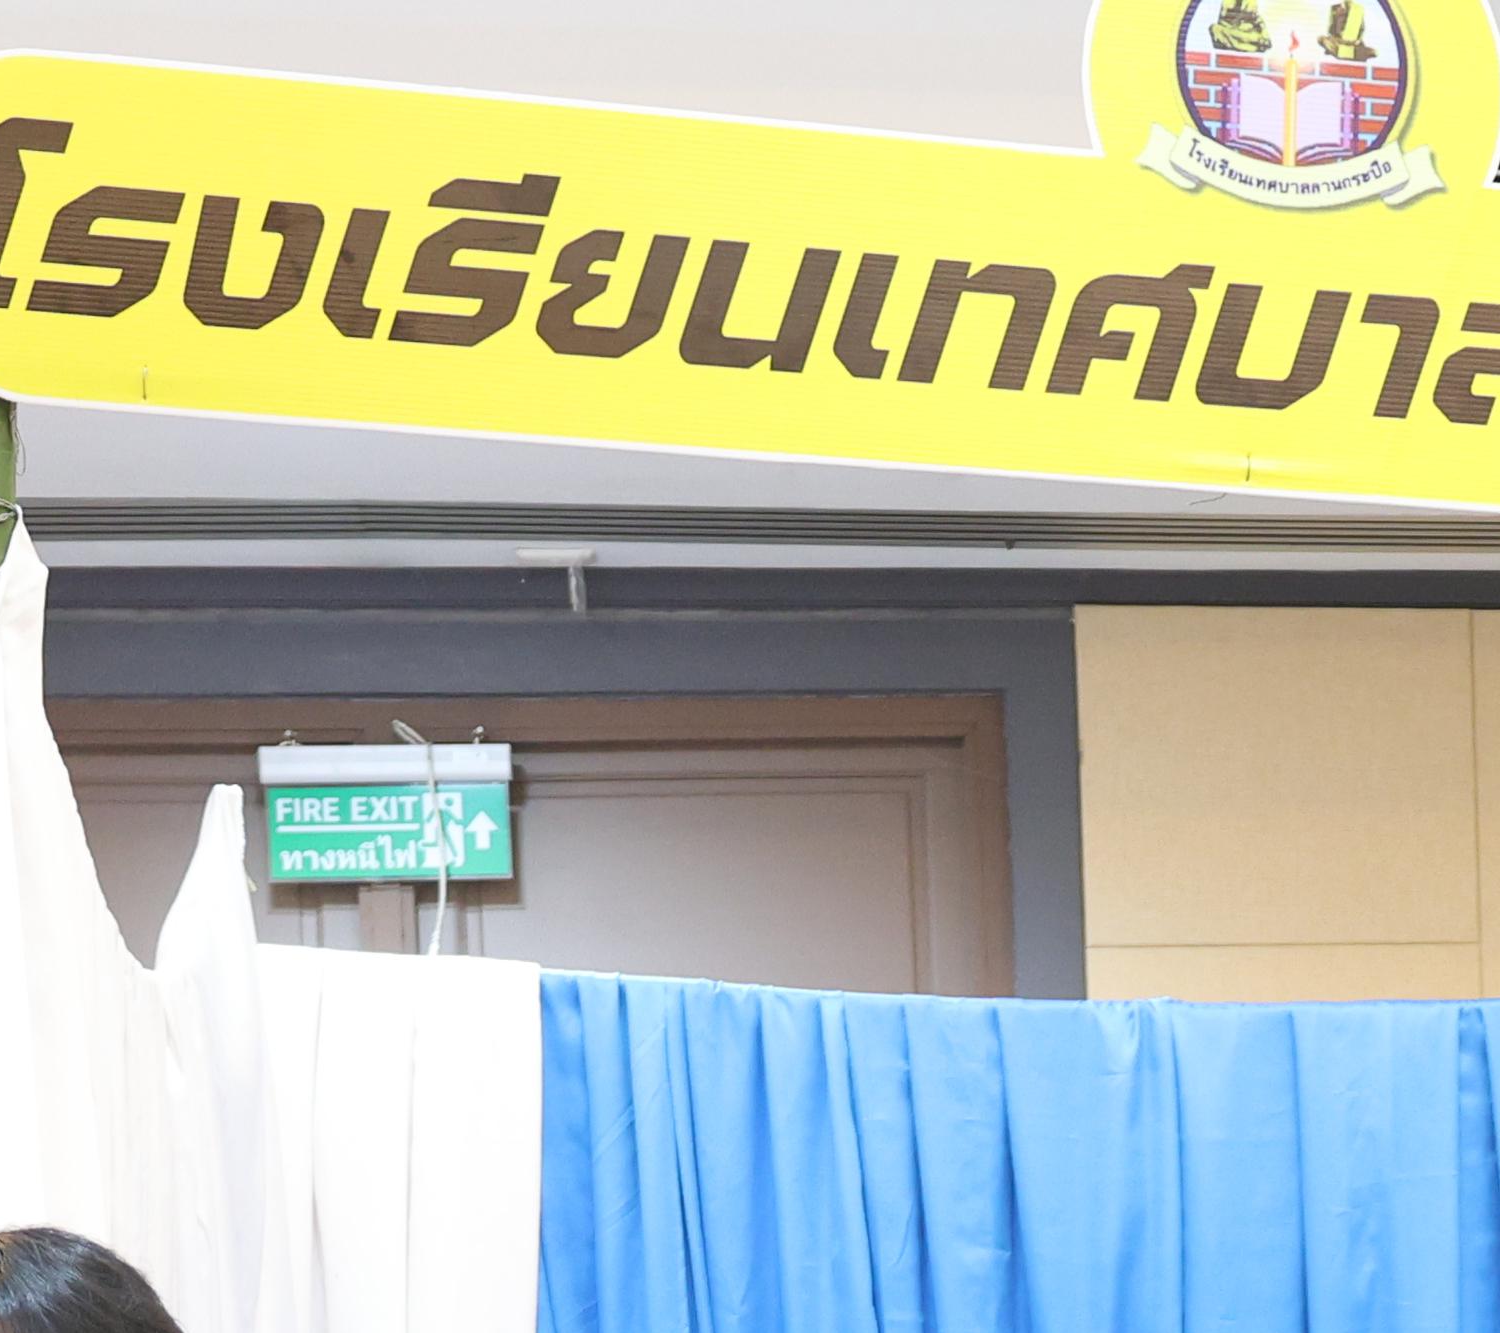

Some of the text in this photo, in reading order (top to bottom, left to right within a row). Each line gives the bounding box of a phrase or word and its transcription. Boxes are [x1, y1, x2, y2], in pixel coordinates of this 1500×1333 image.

[276, 795, 419, 823] FIRE EXIT
[280, 834, 418, 872] ทางหนีไฟ
